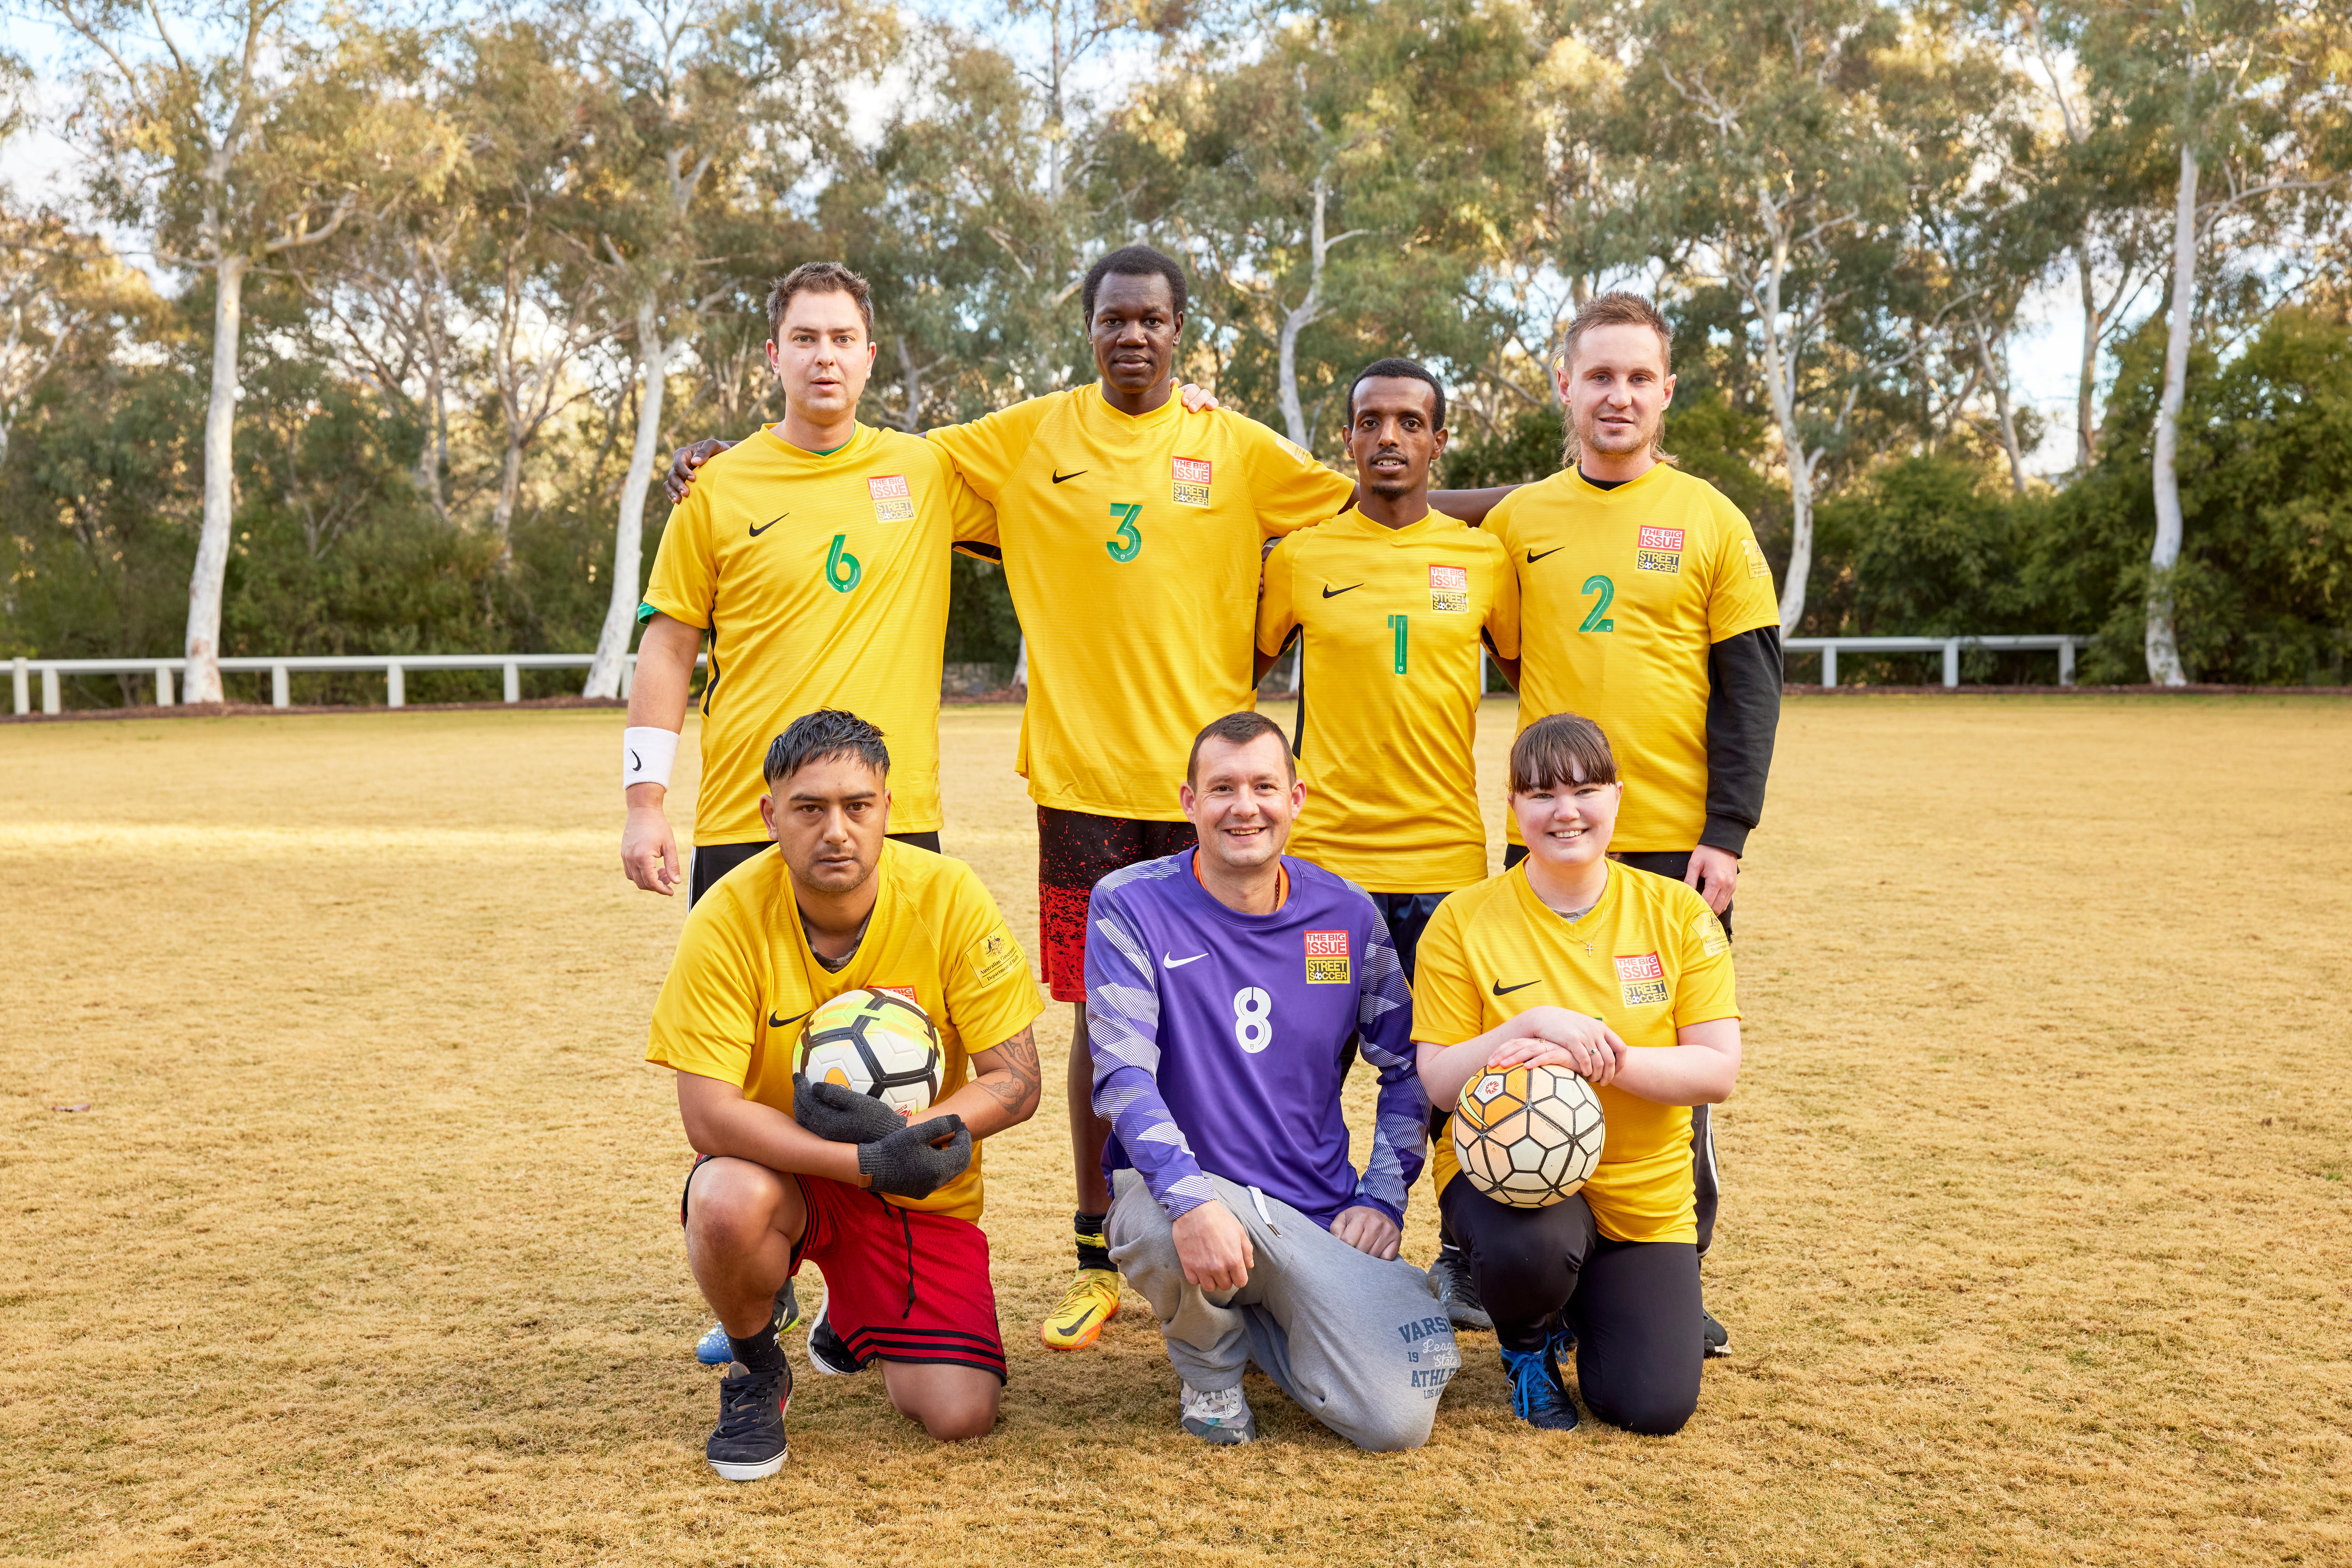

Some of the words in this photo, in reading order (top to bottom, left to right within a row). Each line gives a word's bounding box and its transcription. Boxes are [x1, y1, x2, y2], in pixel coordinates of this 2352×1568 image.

[1175, 459, 1192, 468] THE
[1175, 467, 1208, 482] ISSUE
[872, 484, 907, 497] ISSUE
[1174, 483, 1208, 497] STREET
[1174, 493, 1208, 505] SOCCER
[876, 500, 909, 513] STREET
[1106, 503, 1143, 563] 3
[1641, 535, 1681, 548] ISSUE
[826, 534, 861, 593] 6
[1639, 551, 1678, 564] STREET
[1638, 561, 1677, 572] SOCCER
[1432, 575, 1464, 588] ISSUE
[1433, 592, 1465, 604] STREET
[1579, 575, 1614, 633] 2
[1433, 602, 1466, 611] SOCCER
[1388, 615, 1407, 674] 1
[1308, 942, 1346, 954] ISSUE
[980, 959, 1001, 975] Australian
[1309, 960, 1346, 972] STREET
[1638, 956, 1656, 965] BIG
[987, 965, 1009, 981] Department
[1309, 971, 1347, 980] SOCCER
[1619, 963, 1660, 978] ISSUE
[1624, 981, 1663, 996] STREET
[1626, 992, 1668, 1005] SOCCER
[1233, 987, 1272, 1053] 8
[1408, 1352, 1419, 1362] 19
[1433, 1354, 1457, 1367] State
[1411, 1367, 1459, 1387] ATHLE
[1423, 1389, 1434, 1400] LOS
